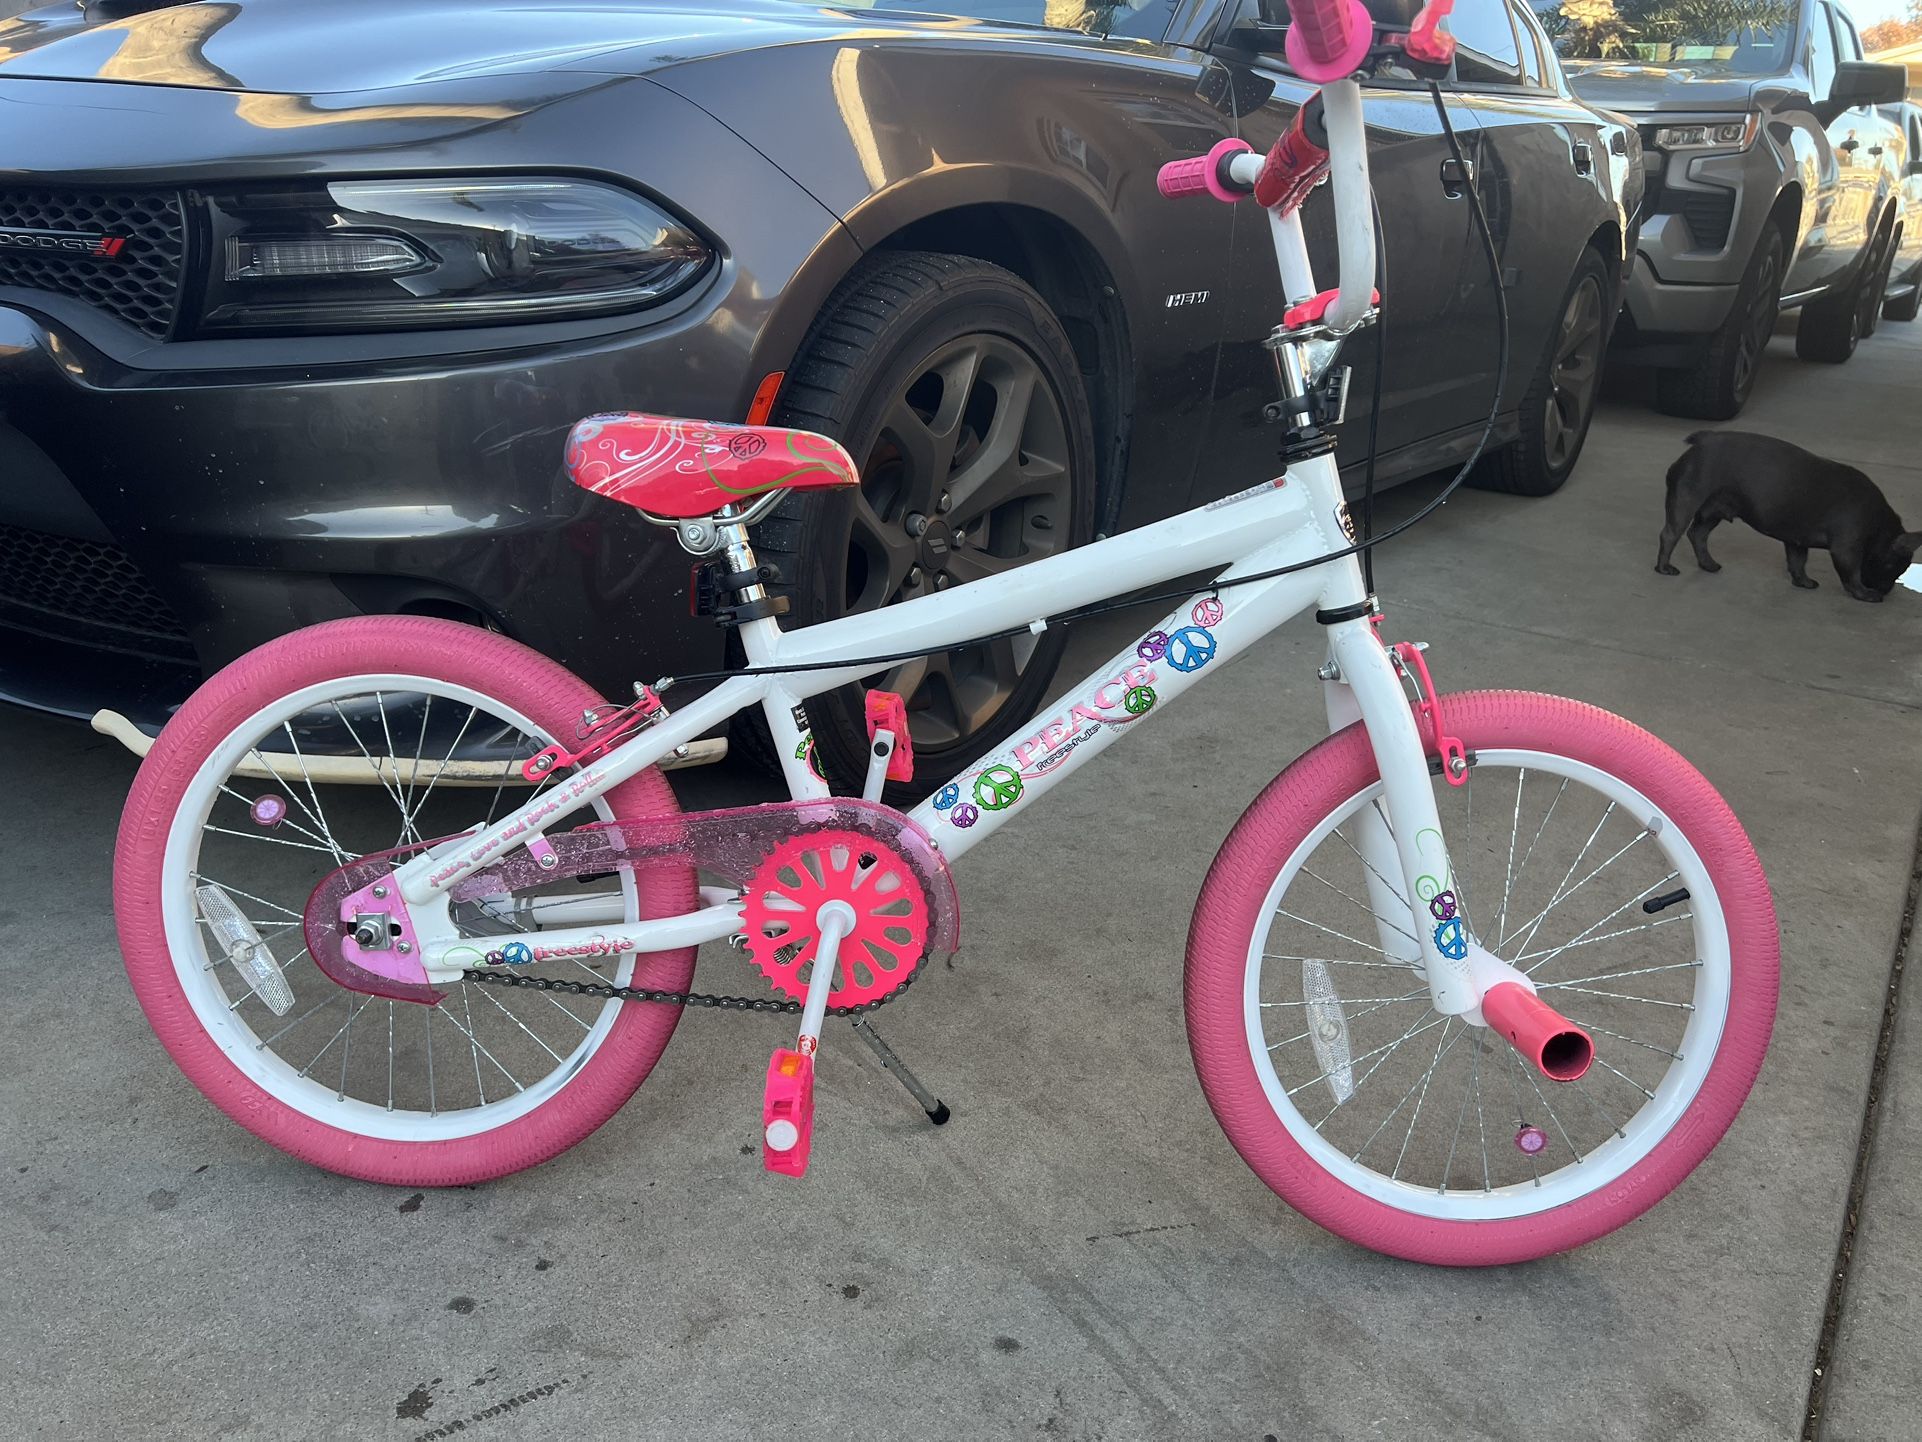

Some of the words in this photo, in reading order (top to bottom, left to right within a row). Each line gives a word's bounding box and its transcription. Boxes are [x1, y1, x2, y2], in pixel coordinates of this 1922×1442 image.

[1012, 660, 1158, 772] PEACE
[1036, 723, 1102, 772] freestyle
[470, 838, 500, 861] Love
[501, 820, 528, 841] and
[525, 800, 560, 826] Rock
